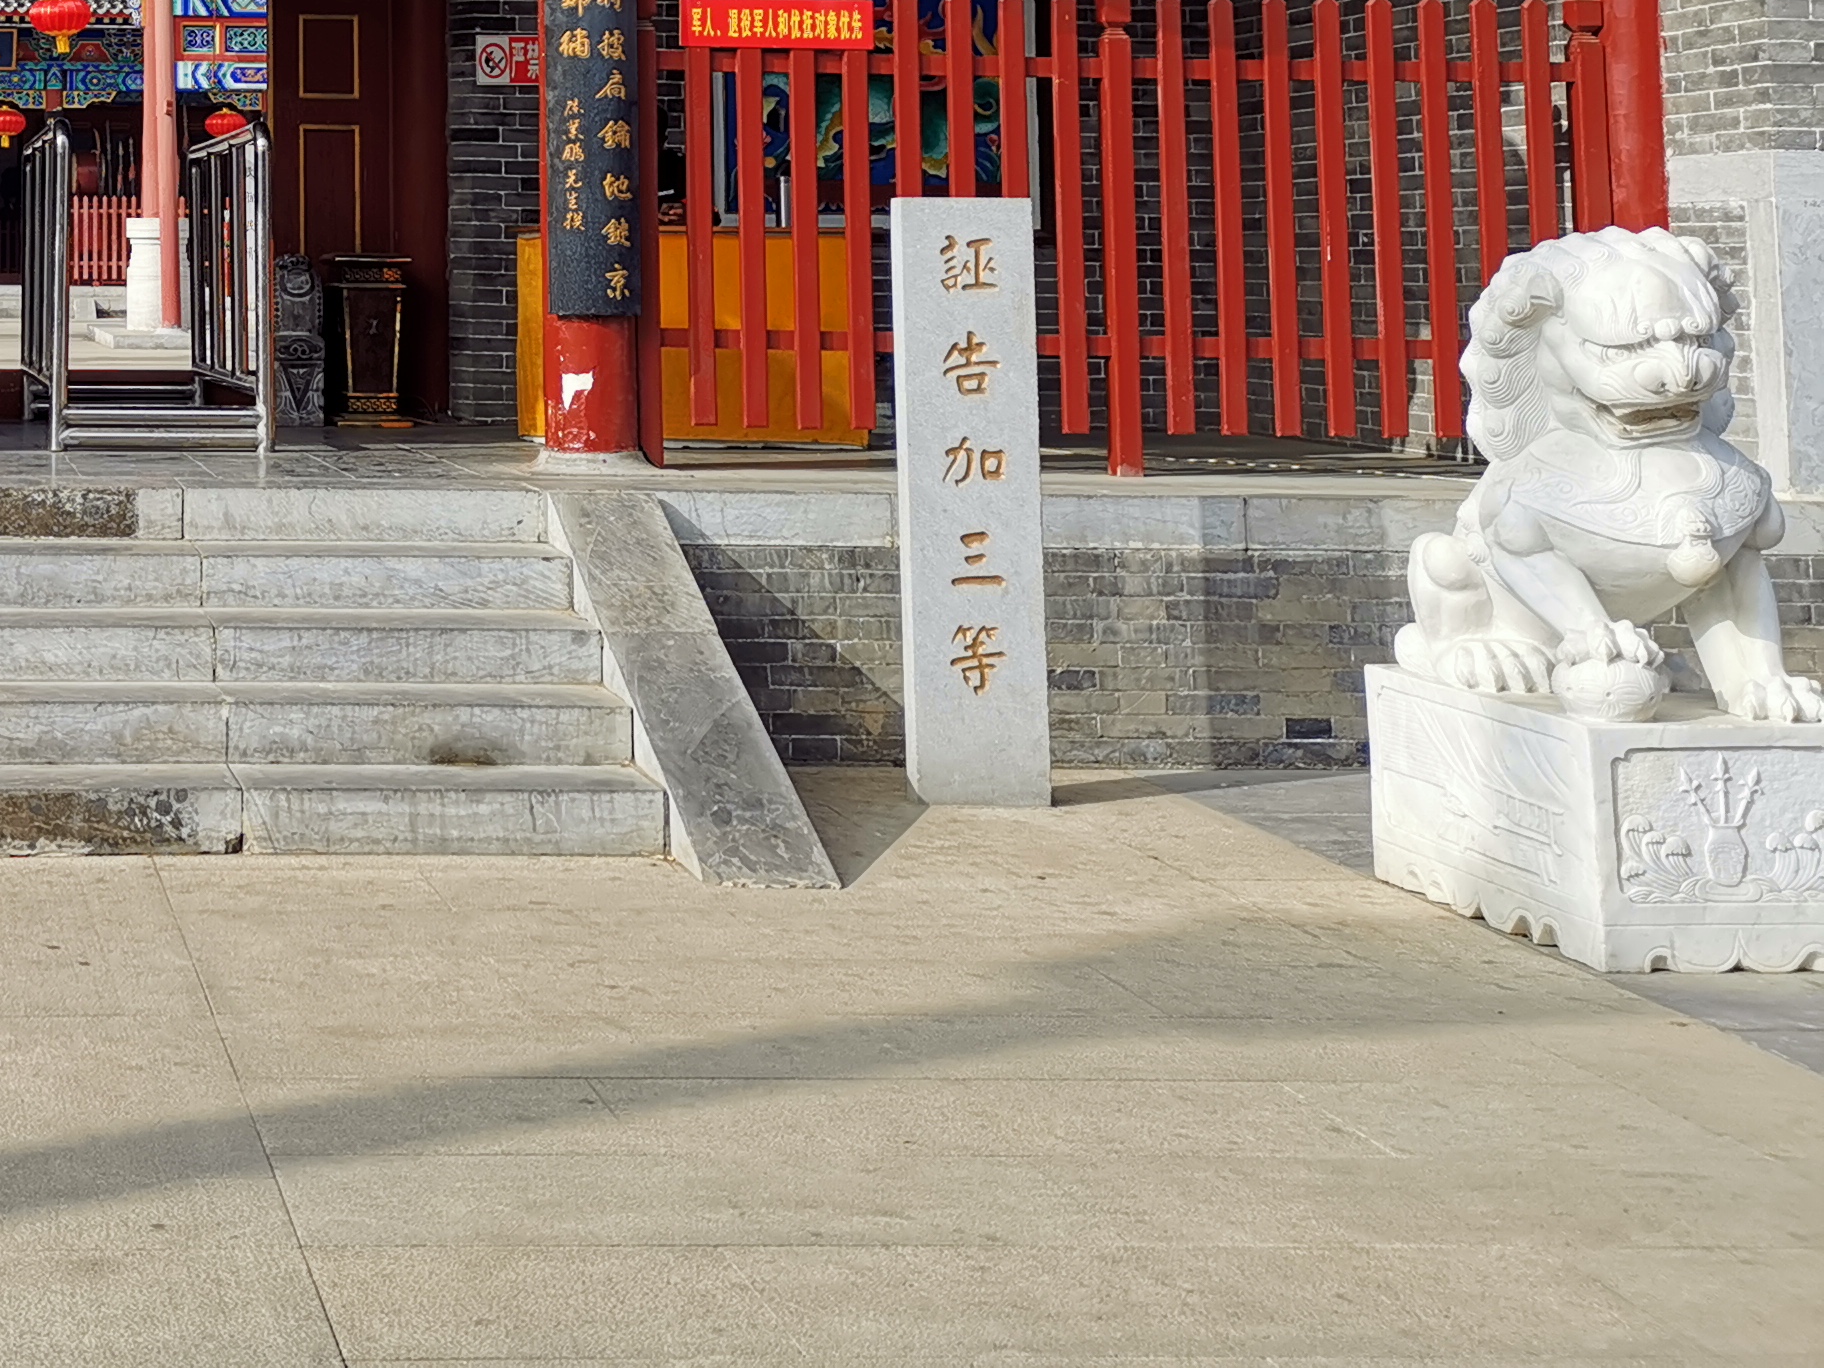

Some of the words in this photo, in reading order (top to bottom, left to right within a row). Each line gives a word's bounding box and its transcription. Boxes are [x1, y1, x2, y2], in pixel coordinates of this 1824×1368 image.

[691, 8, 863, 40] 军人、退役军人和优抚对象优先
[939, 235, 1008, 696] 誣告加三等
